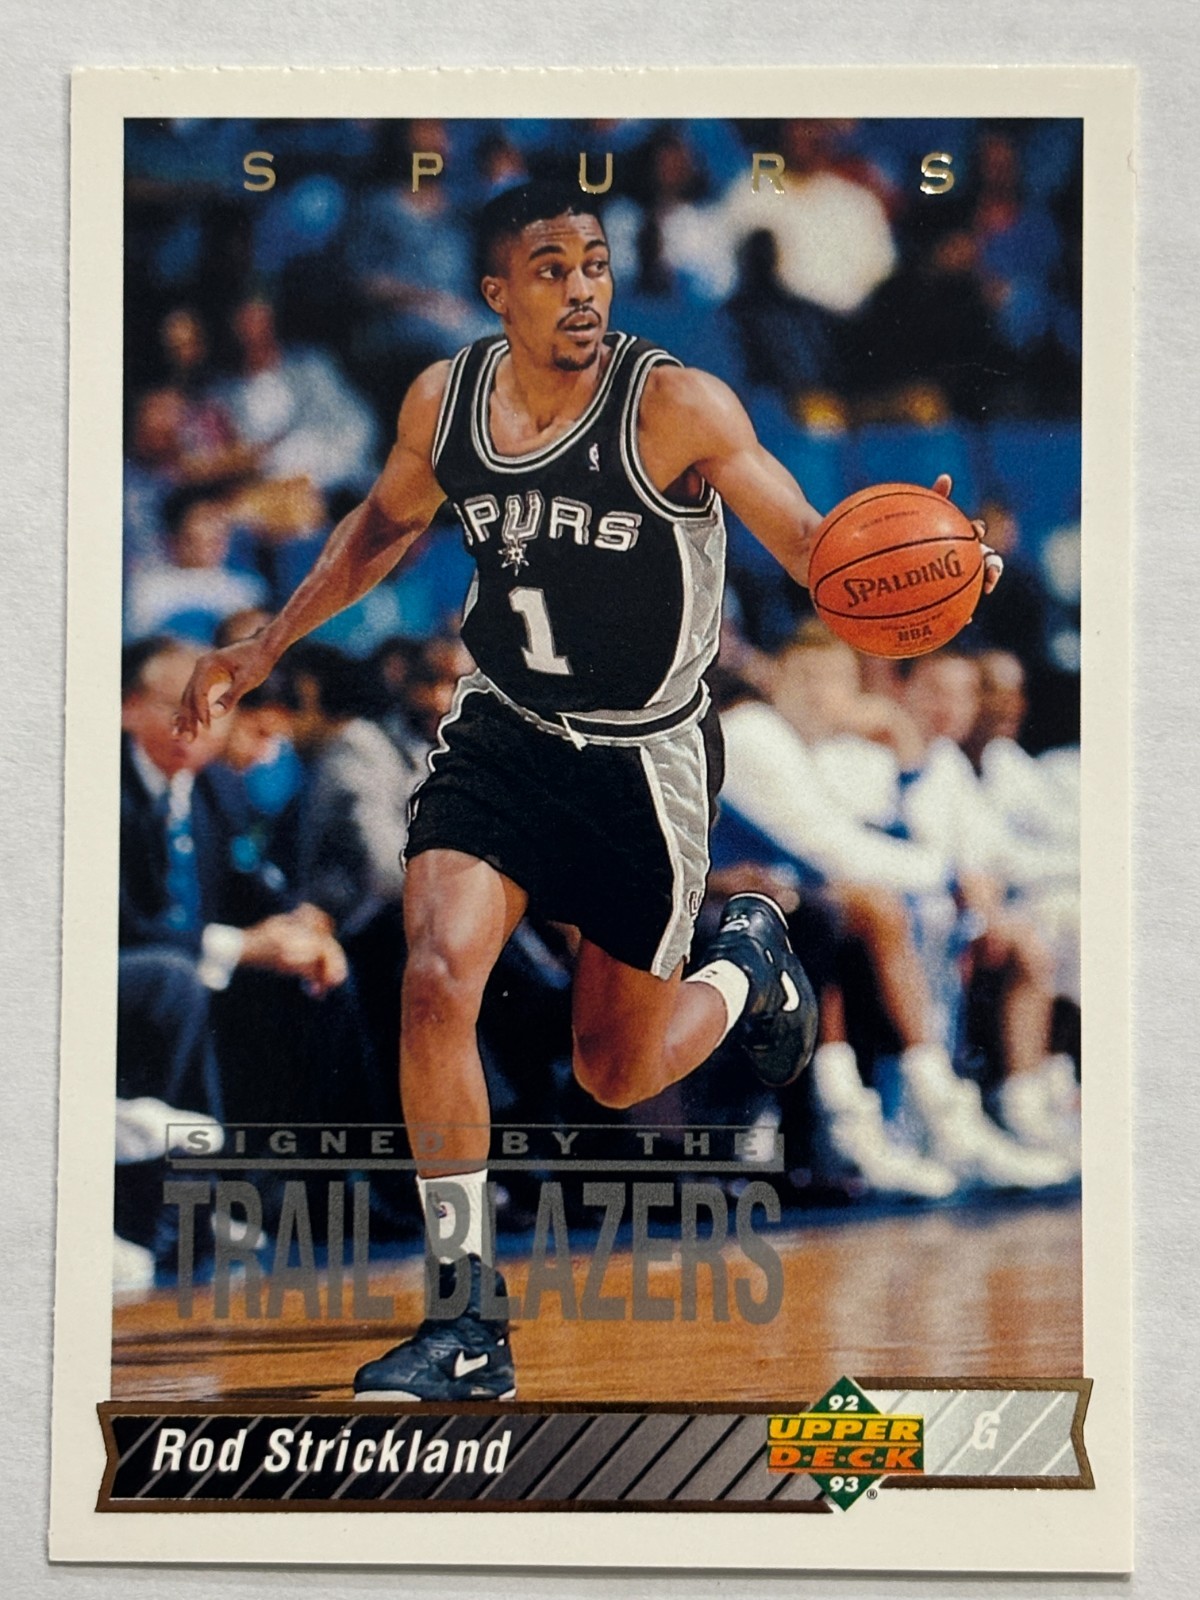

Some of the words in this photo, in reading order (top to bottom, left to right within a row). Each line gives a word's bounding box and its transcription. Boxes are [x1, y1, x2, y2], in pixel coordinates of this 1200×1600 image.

[243, 151, 955, 195] SPURS
[843, 549, 962, 608] SPALDING
[508, 586, 574, 676] 1
[897, 624, 933, 642] NBA
[187, 1130, 445, 1154] SIGNED
[502, 1131, 579, 1155] BY
[636, 1132, 758, 1157] THE
[163, 1180, 395, 1320] TRAIL
[423, 1181, 784, 1325] BLAZERS
[828, 1394, 859, 1411] 92
[769, 1418, 921, 1441] UPPER
[972, 1410, 1001, 1450] G
[151, 1428, 247, 1472] Rod
[264, 1428, 512, 1474] Strickland
[829, 1475, 859, 1493] 93
